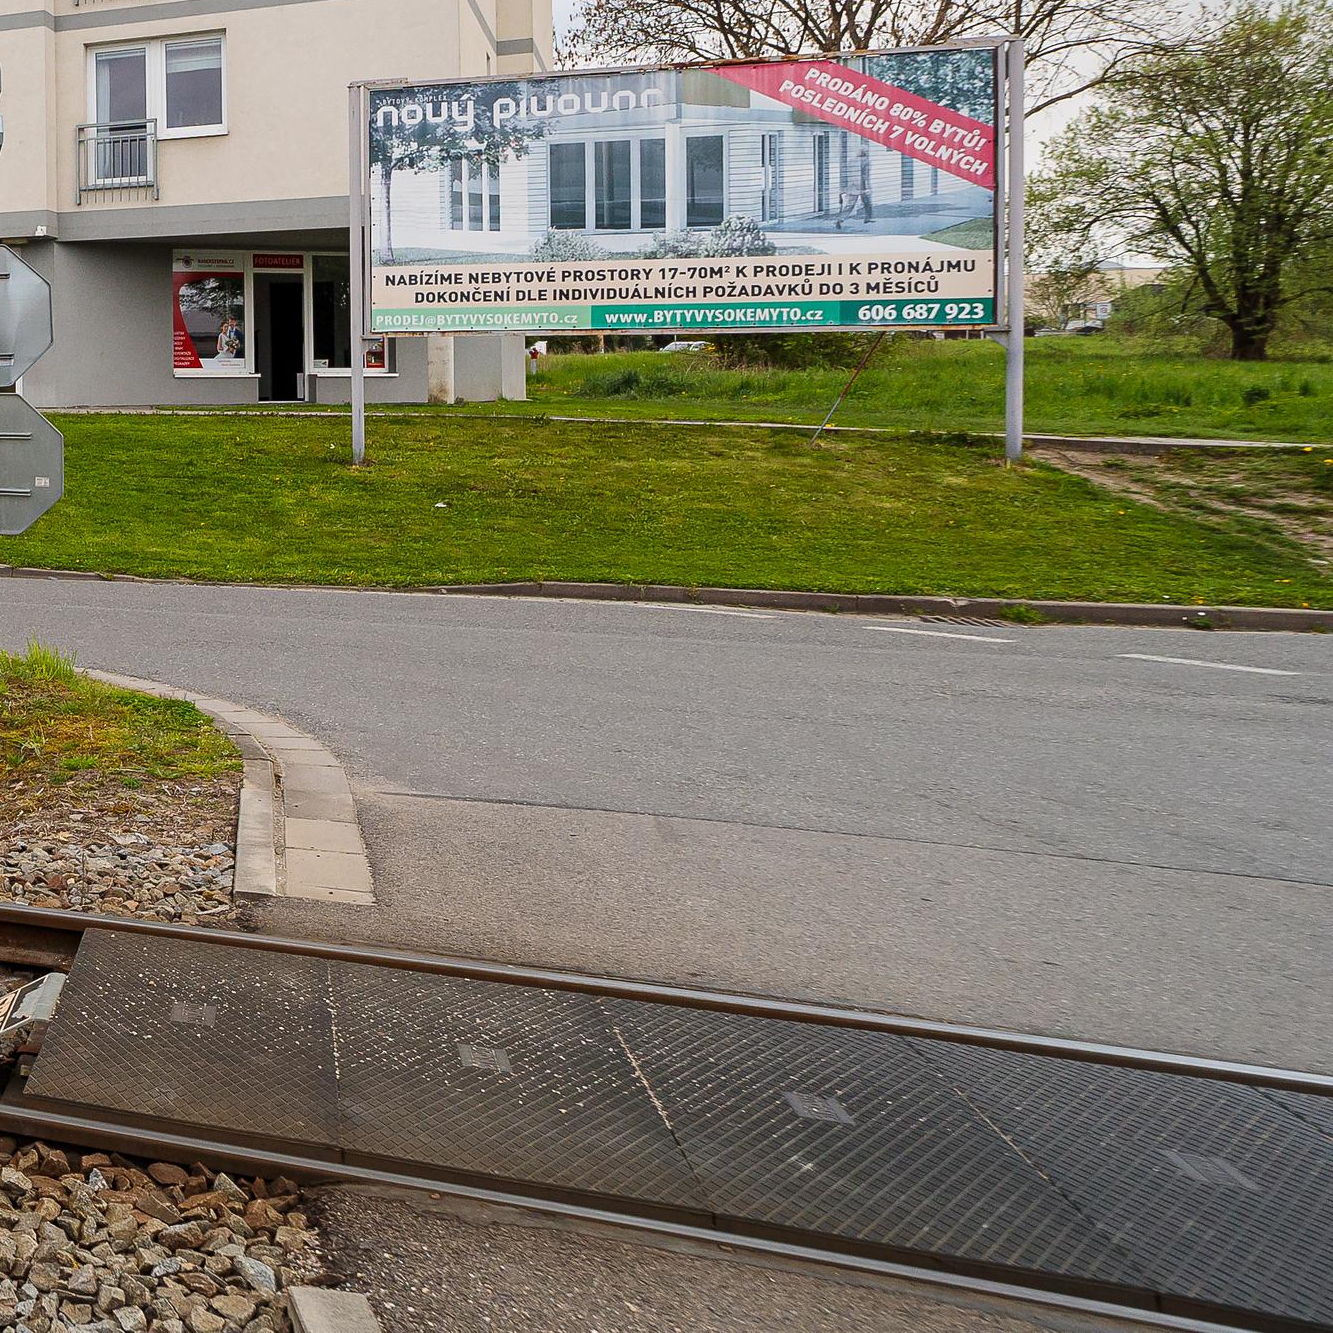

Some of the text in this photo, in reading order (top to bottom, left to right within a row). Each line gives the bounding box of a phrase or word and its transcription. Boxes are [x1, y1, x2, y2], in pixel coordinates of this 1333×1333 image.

[804, 67, 988, 152] PRODÁNO 80% BYTŮ!
[779, 80, 989, 176] POSLEDNÍCH 7 VOLNÝCH
[385, 270, 464, 287] NABÍZÍME
[468, 267, 556, 285] NEBYTOVÉ
[561, 267, 654, 283] PROSTORY
[735, 265, 748, 278] K
[753, 263, 833, 278] PRODEJI
[837, 264, 843, 276] I
[849, 263, 863, 276] K
[867, 256, 976, 275] PRONÁJMU
[414, 275, 939, 304] DOKONČENÍ DLE INDIVIDUÁLNÍCH POŽADAVKŮ DO 3 MĚSÍCŮ
[376, 312, 578, 327] PRODEJ@BYTYVYSOKEMYTO.cz
[605, 307, 824, 325] www.BYTYVYSOKEMYTO.cz
[858, 302, 985, 322] 606 687 923
